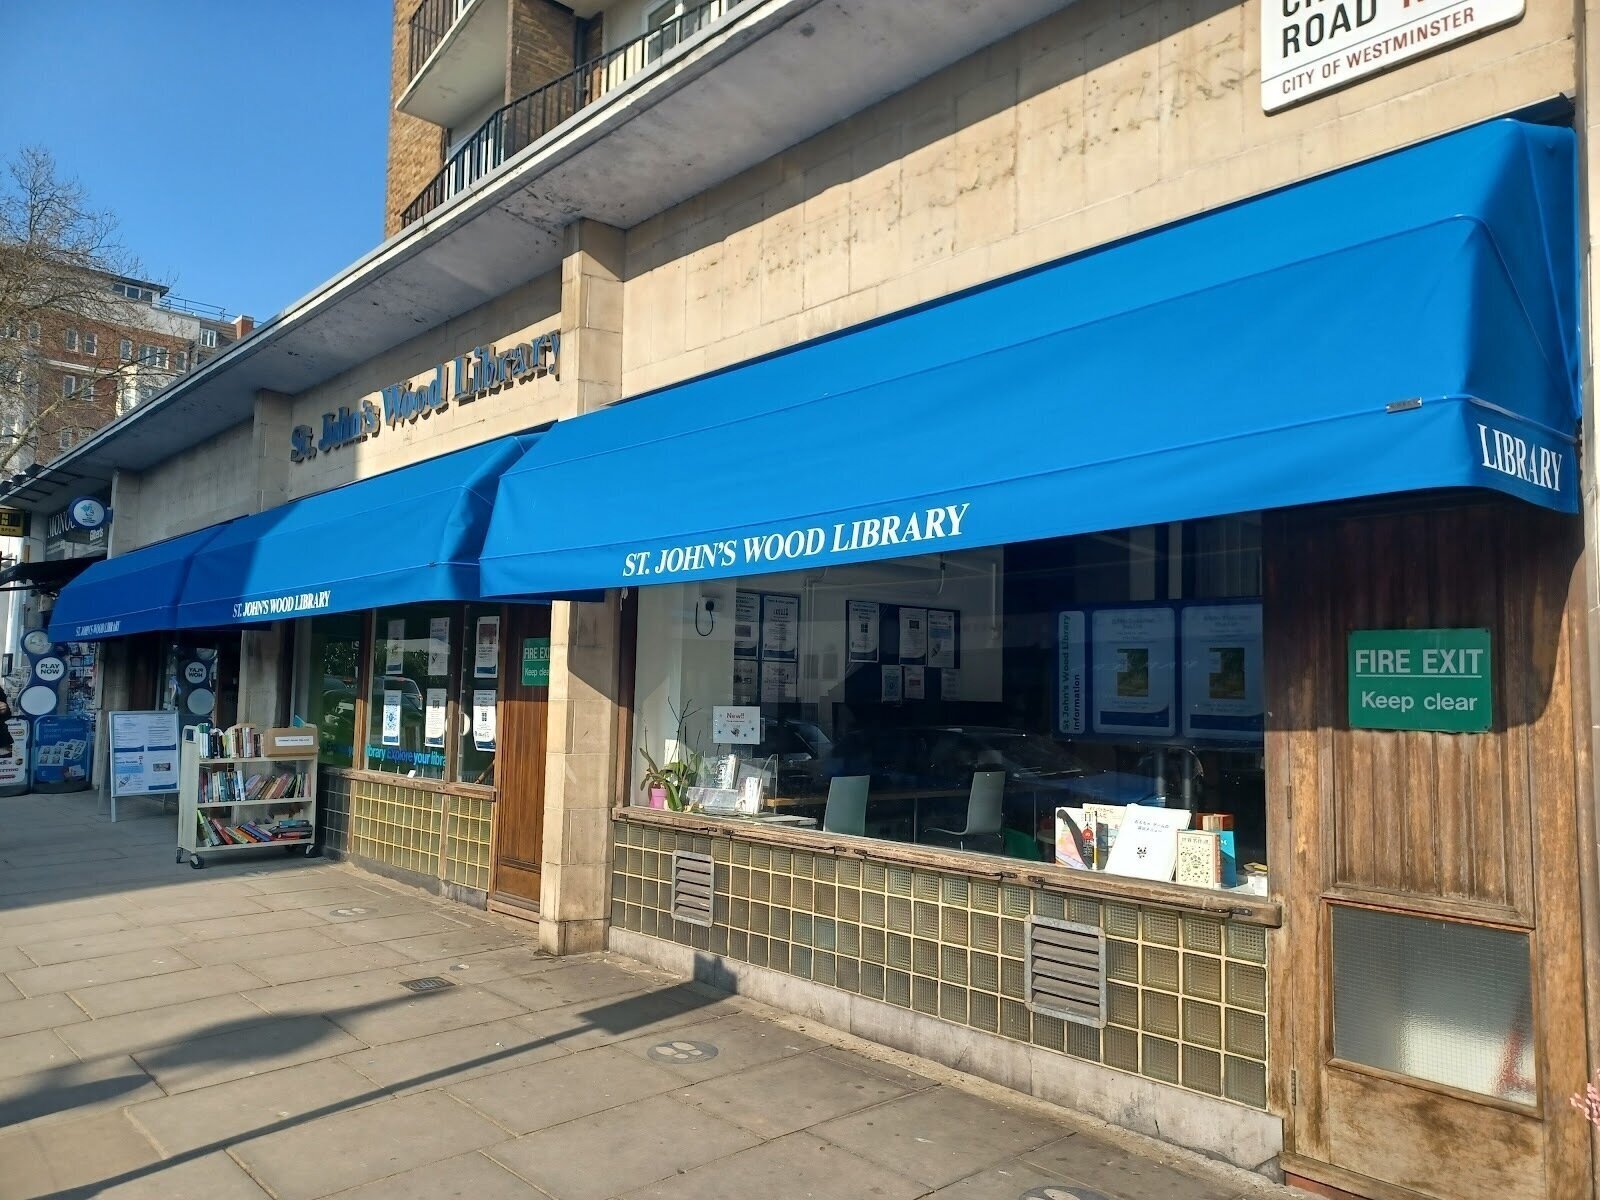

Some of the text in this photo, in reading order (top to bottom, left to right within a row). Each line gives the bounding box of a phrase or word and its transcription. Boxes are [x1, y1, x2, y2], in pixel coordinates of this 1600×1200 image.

[1282, 0, 1377, 58] ROAD
[1282, 69, 1315, 94] CITY
[1321, 59, 1341, 79] OF
[1346, 7, 1474, 69] WESTMINSTER
[290, 329, 561, 462] St. John's Wood Library
[1477, 423, 1562, 491] LIBRARY
[622, 502, 970, 577] ST. JOHN'S WOOD LIBRARY
[232, 590, 331, 618] ST. JOHN'S WOOD LIBRARY
[1062, 615, 1071, 650] Library
[524, 647, 538, 660] FIRE
[1062, 652, 1070, 682] Wood
[1355, 649, 1484, 674] FIRE EXIT
[524, 668, 538, 678] Keep
[1361, 691, 1478, 713] Keep clear
[386, 746, 413, 764] Explore
[413, 751, 430, 766] your
